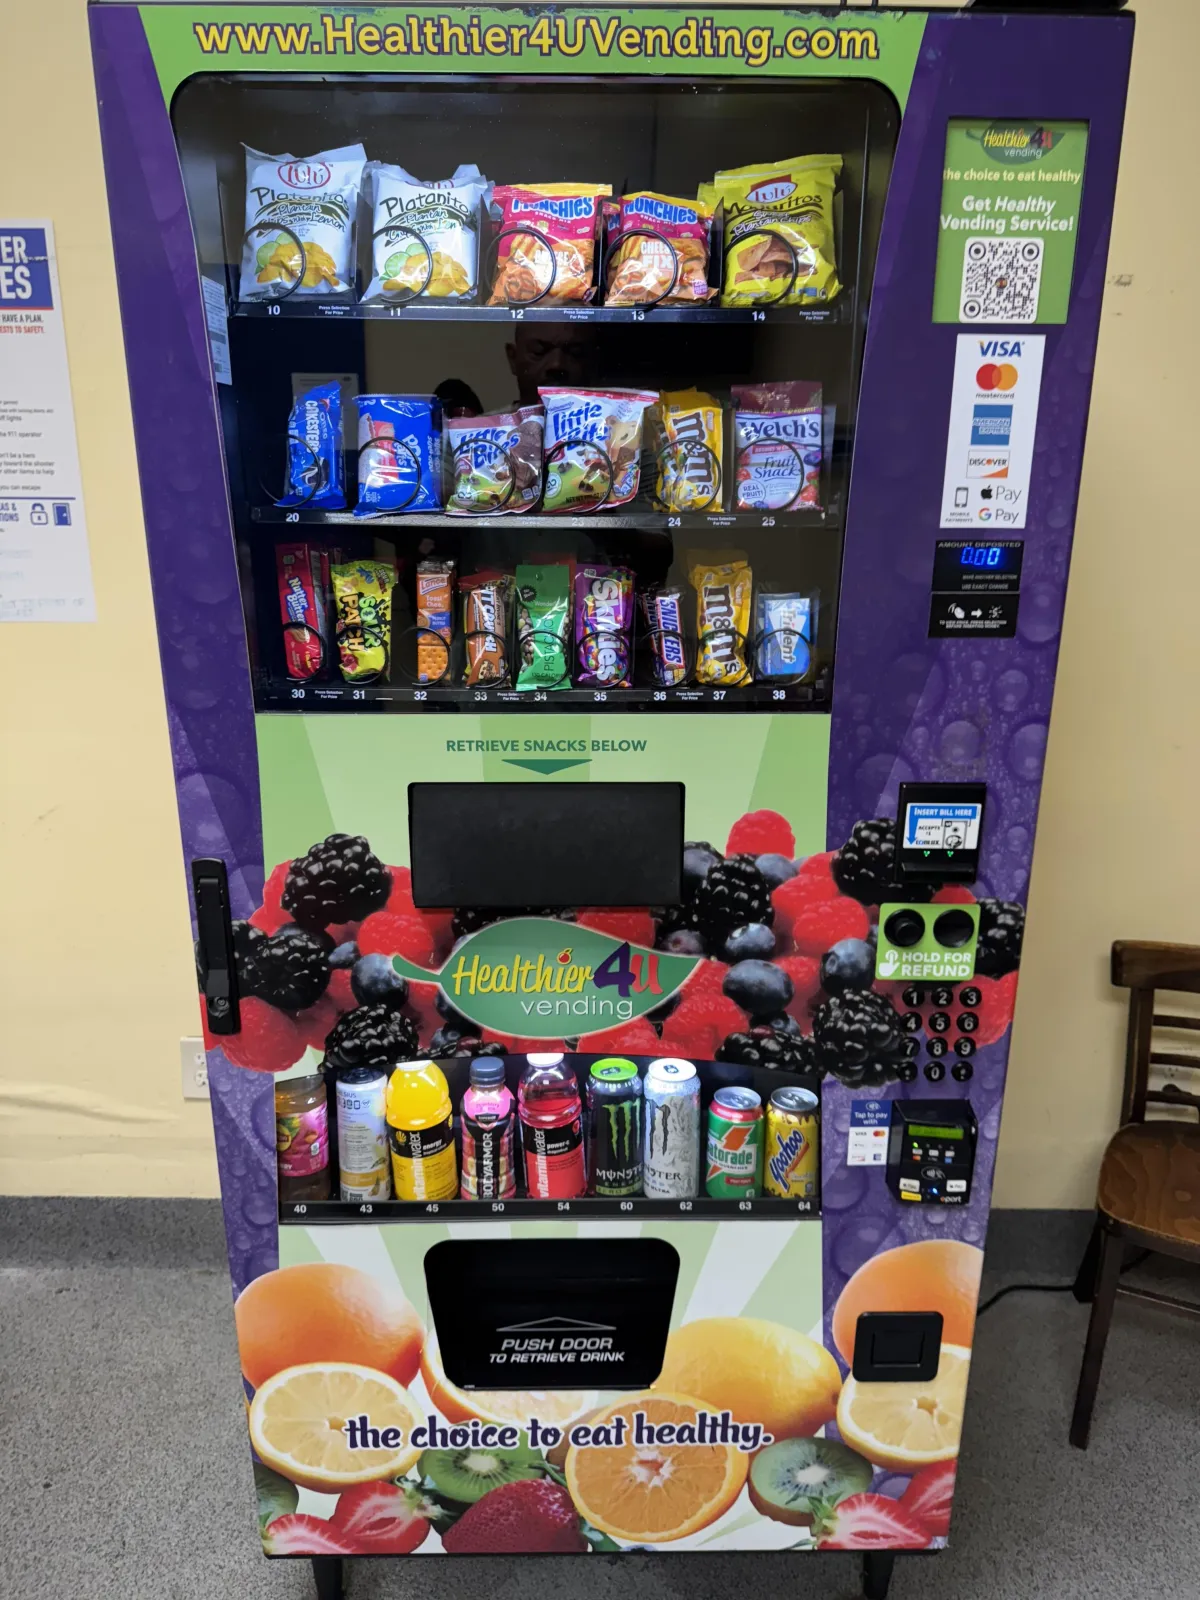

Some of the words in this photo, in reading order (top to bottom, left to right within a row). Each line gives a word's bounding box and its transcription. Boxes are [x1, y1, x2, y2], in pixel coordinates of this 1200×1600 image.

[193, 14, 879, 66] www.Healthier4UVending.com
[1004, 147, 1042, 159] vending
[944, 168, 960, 181] the
[964, 168, 1000, 181] choice
[1003, 170, 1014, 181] to
[1017, 171, 1036, 182] eat
[1038, 169, 1080, 185] healthy
[962, 195, 991, 212] Get
[995, 196, 1056, 217] Healthy
[940, 214, 1006, 234] Vending
[1010, 215, 1074, 232] Service!
[642, 254, 673, 269] FIX
[267, 305, 281, 316] 10
[510, 309, 524, 320] 12
[631, 311, 645, 321] 13
[752, 311, 766, 321] 14
[2, 314, 18, 323] HAVE
[19, 314, 24, 323] A
[25, 314, 44, 323] PLAN.
[15, 326, 23, 334] TO
[23, 326, 46, 334] SAFETY.
[978, 340, 1022, 357] VISA
[305, 400, 320, 454] CAKESTERS
[738, 418, 820, 441] Welch's
[763, 455, 798, 470] Fruit
[969, 457, 1007, 467] DISCOVER
[995, 485, 1022, 503] Pay
[285, 512, 300, 523] 20
[571, 516, 584, 526] 23
[668, 517, 682, 527] 24
[762, 517, 776, 527] 25
[995, 508, 1020, 524] Pay
[938, 541, 973, 549] AMOUNT
[421, 577, 447, 590] Lance
[288, 577, 309, 609] Nutter
[358, 595, 382, 648] SOUR
[660, 599, 682, 664] SNICERS
[291, 689, 305, 699] 30
[353, 690, 366, 700] 31
[414, 691, 427, 701] 32
[474, 691, 487, 701] 33
[534, 691, 547, 701] 34
[594, 691, 607, 701] 35
[653, 691, 667, 701] 36
[713, 690, 726, 700] 37
[772, 690, 786, 700] 38
[446, 739, 519, 752] RETRIEVE
[523, 739, 587, 752] SNACKS
[591, 739, 647, 752] BELOW
[914, 807, 938, 816] INSERT
[939, 807, 954, 816] BILL
[954, 808, 972, 816] HERE
[902, 951, 941, 963] HOLD
[944, 952, 972, 964] FOR
[901, 964, 971, 977] REFUND
[911, 992, 918, 1005] 1
[938, 991, 947, 1004] 2
[967, 991, 977, 1005] 3
[520, 995, 634, 1020] vending
[907, 1017, 916, 1030] 4
[936, 1017, 945, 1030] 5
[964, 1017, 974, 1030] 6
[906, 1042, 914, 1055] 7
[933, 1042, 942, 1055] 8
[961, 1042, 971, 1055] 9
[931, 1066, 940, 1080] 0
[854, 1111, 867, 1120] Tap
[867, 1111, 875, 1119] to
[875, 1112, 888, 1120] pay
[422, 1138, 443, 1150] energy
[294, 1204, 307, 1213] 40
[360, 1204, 373, 1213] 43
[426, 1203, 439, 1212] 45
[491, 1203, 505, 1211] 50
[557, 1202, 570, 1211] 54
[620, 1202, 633, 1211] 60
[679, 1202, 693, 1211] 62
[739, 1201, 752, 1210] 63
[798, 1201, 811, 1210] 64
[501, 1338, 554, 1351] PUSH
[560, 1338, 613, 1350] DOOR
[490, 1353, 507, 1363] TO
[510, 1352, 577, 1363] RETRIEVE
[580, 1351, 625, 1362] DRINK
[344, 1414, 400, 1450] the
[410, 1414, 518, 1449] choice
[526, 1418, 565, 1449] to
[571, 1418, 627, 1448] eat
[634, 1411, 773, 1451] healthy.
